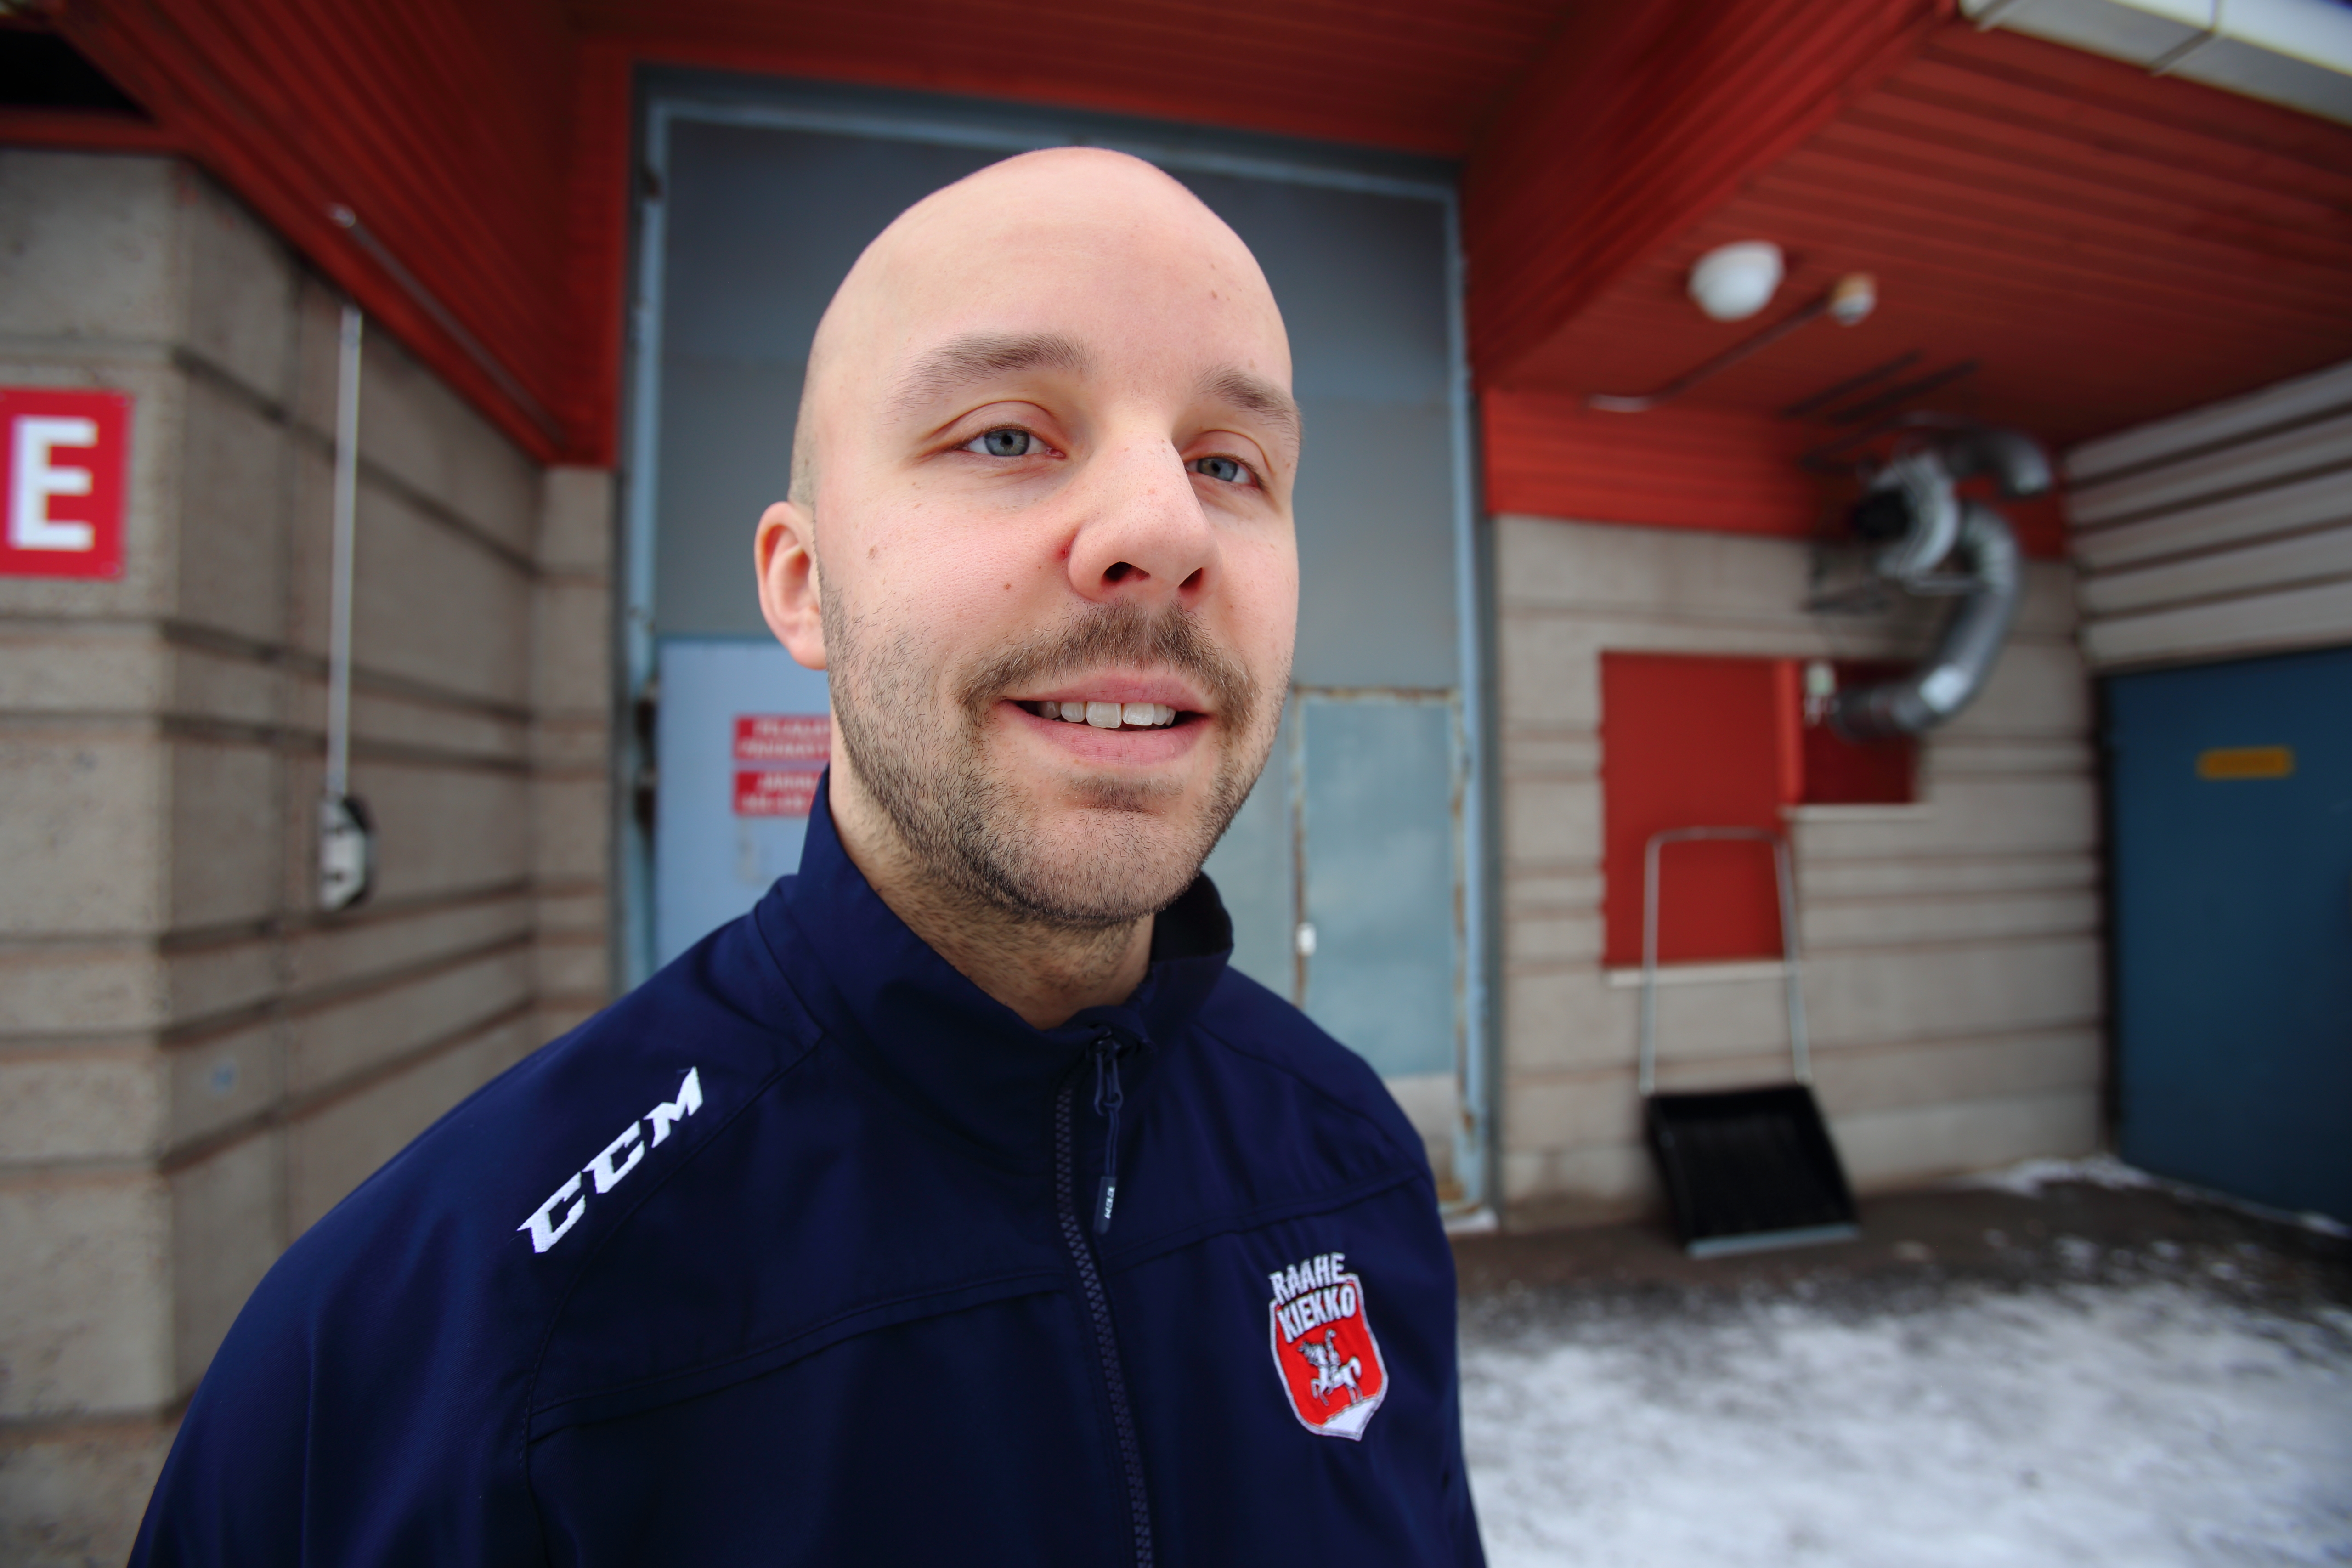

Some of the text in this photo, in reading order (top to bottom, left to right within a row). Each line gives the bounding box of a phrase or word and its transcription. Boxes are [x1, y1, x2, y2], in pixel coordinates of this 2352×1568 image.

[7, 414, 99, 552] E
[516, 1065, 703, 1253] CCM
[1269, 1252, 1345, 1306] RAAHE
[1277, 1284, 1356, 1344] KIEKKO
